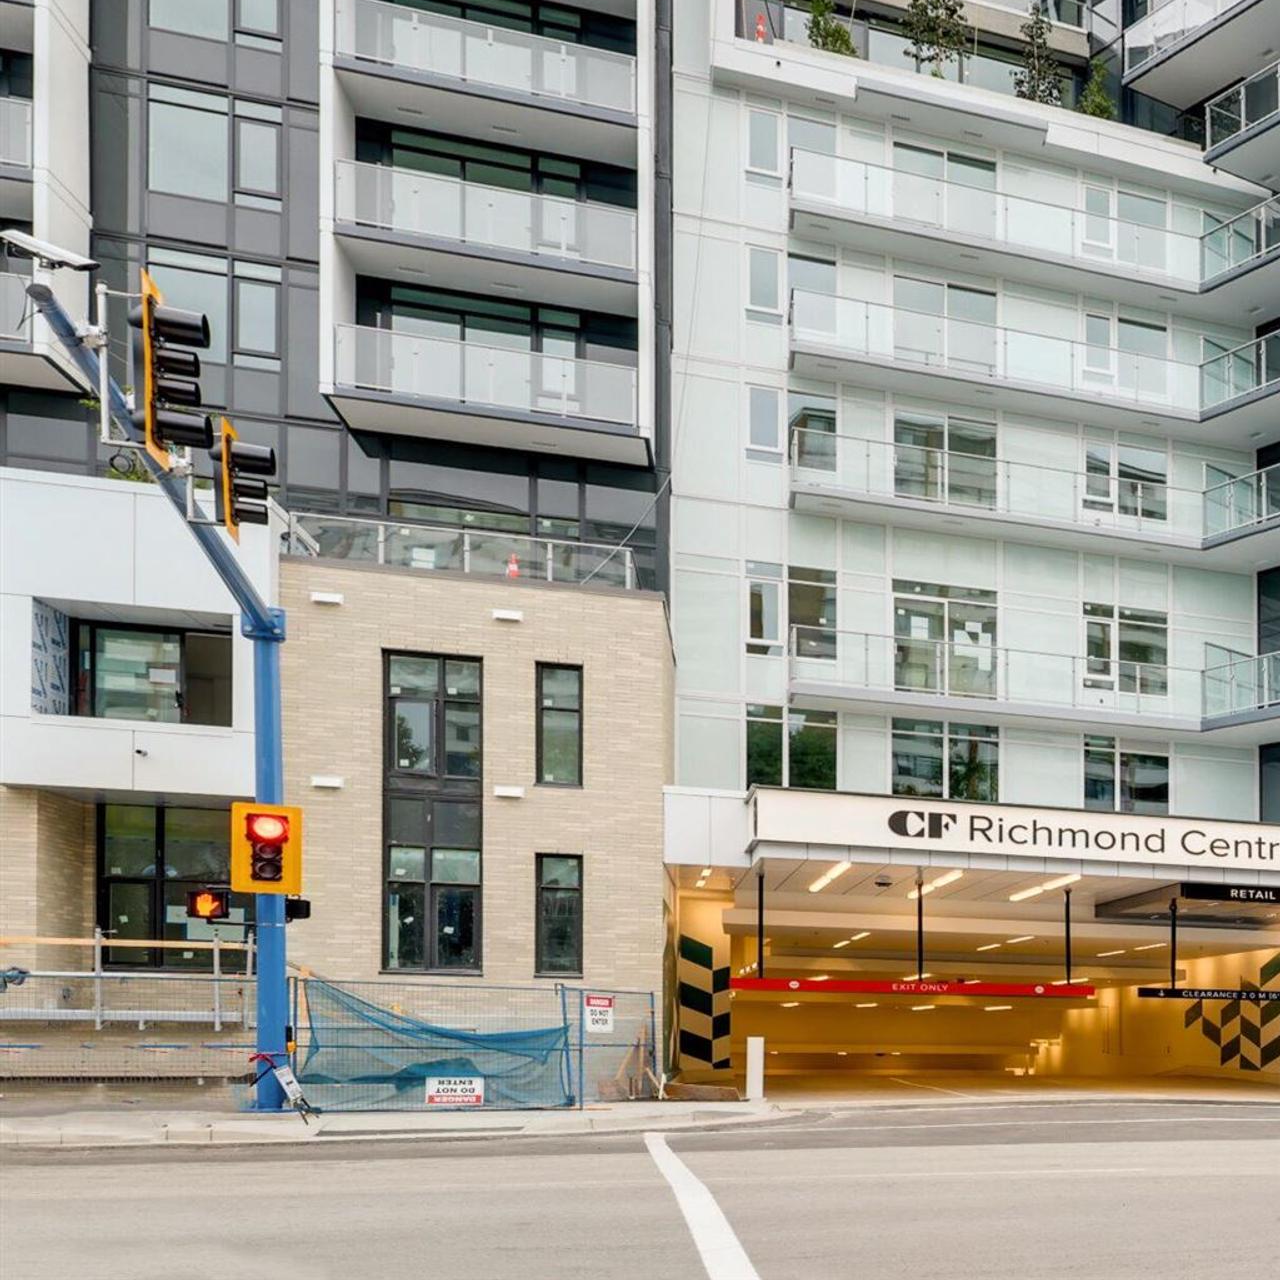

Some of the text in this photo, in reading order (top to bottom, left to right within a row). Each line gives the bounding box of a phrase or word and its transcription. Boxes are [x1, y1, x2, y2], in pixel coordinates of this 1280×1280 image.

[889, 810, 957, 838] CF
[968, 815, 1166, 854] Richmond
[1230, 888, 1277, 900] RETAIL
[892, 983, 949, 992] EXIT ONLY
[1182, 990, 1238, 999] CLEARANCE
